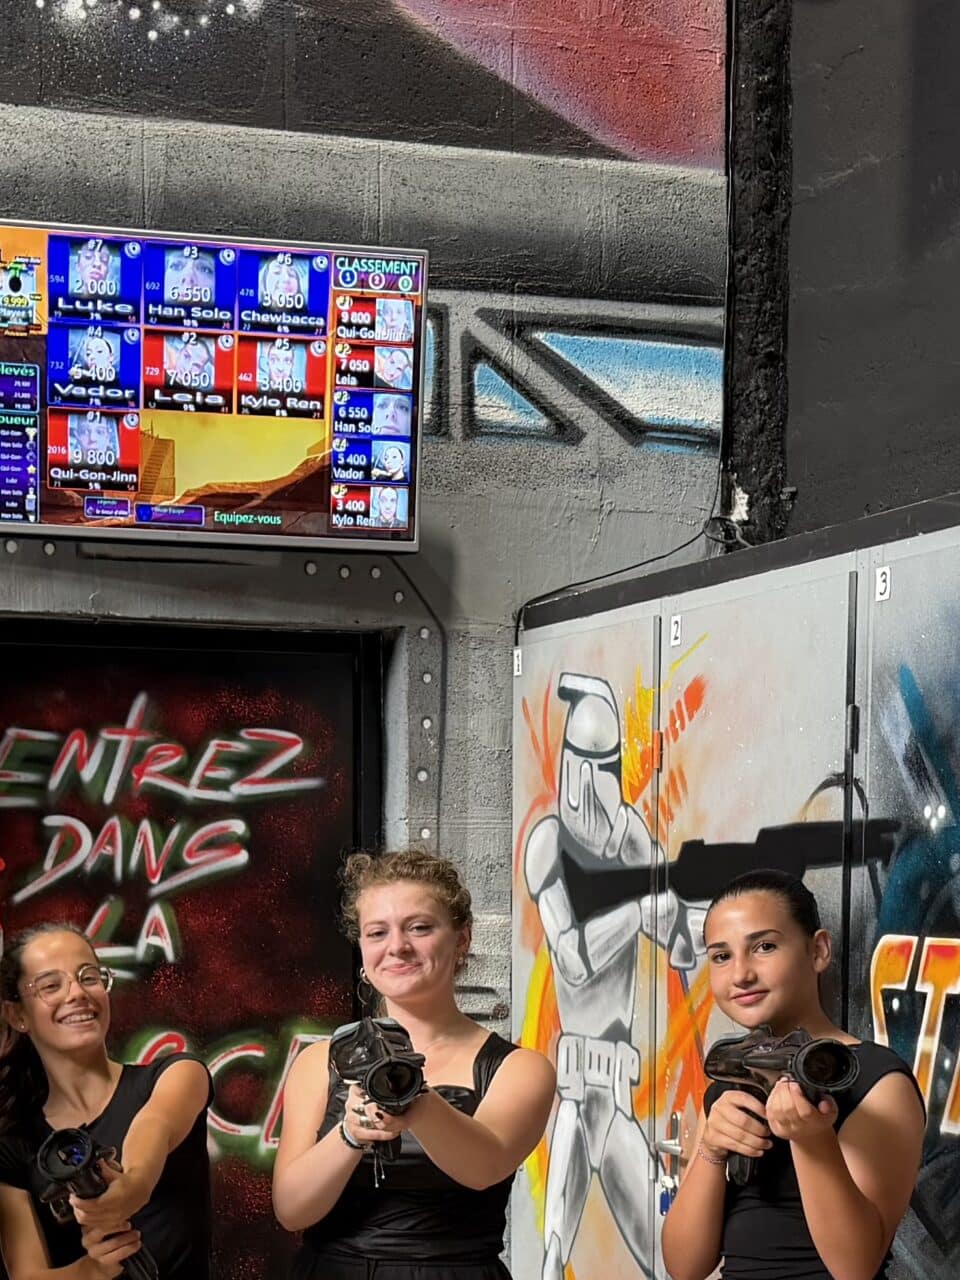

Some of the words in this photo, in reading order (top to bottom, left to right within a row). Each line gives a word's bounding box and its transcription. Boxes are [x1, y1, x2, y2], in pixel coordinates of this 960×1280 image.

[336, 257, 418, 275] CLASSEMENT
[58, 297, 133, 313] Luke
[149, 304, 185, 317] Han
[191, 307, 231, 320] Solo
[241, 310, 325, 325] Chewbacca
[336, 374, 358, 385] Leia
[54, 383, 136, 399] Vador
[154, 389, 225, 404] Leia
[241, 395, 280, 409] Kylo
[286, 397, 321, 409] Ren
[334, 422, 355, 433] Han
[50, 467, 137, 483] Qui-Gon-Jinn
[333, 468, 364, 480] Vador
[214, 510, 282, 525] Equipez-vous
[879, 571, 887, 596] 3
[673, 620, 679, 640] 2
[14, 815, 249, 905] DANS
